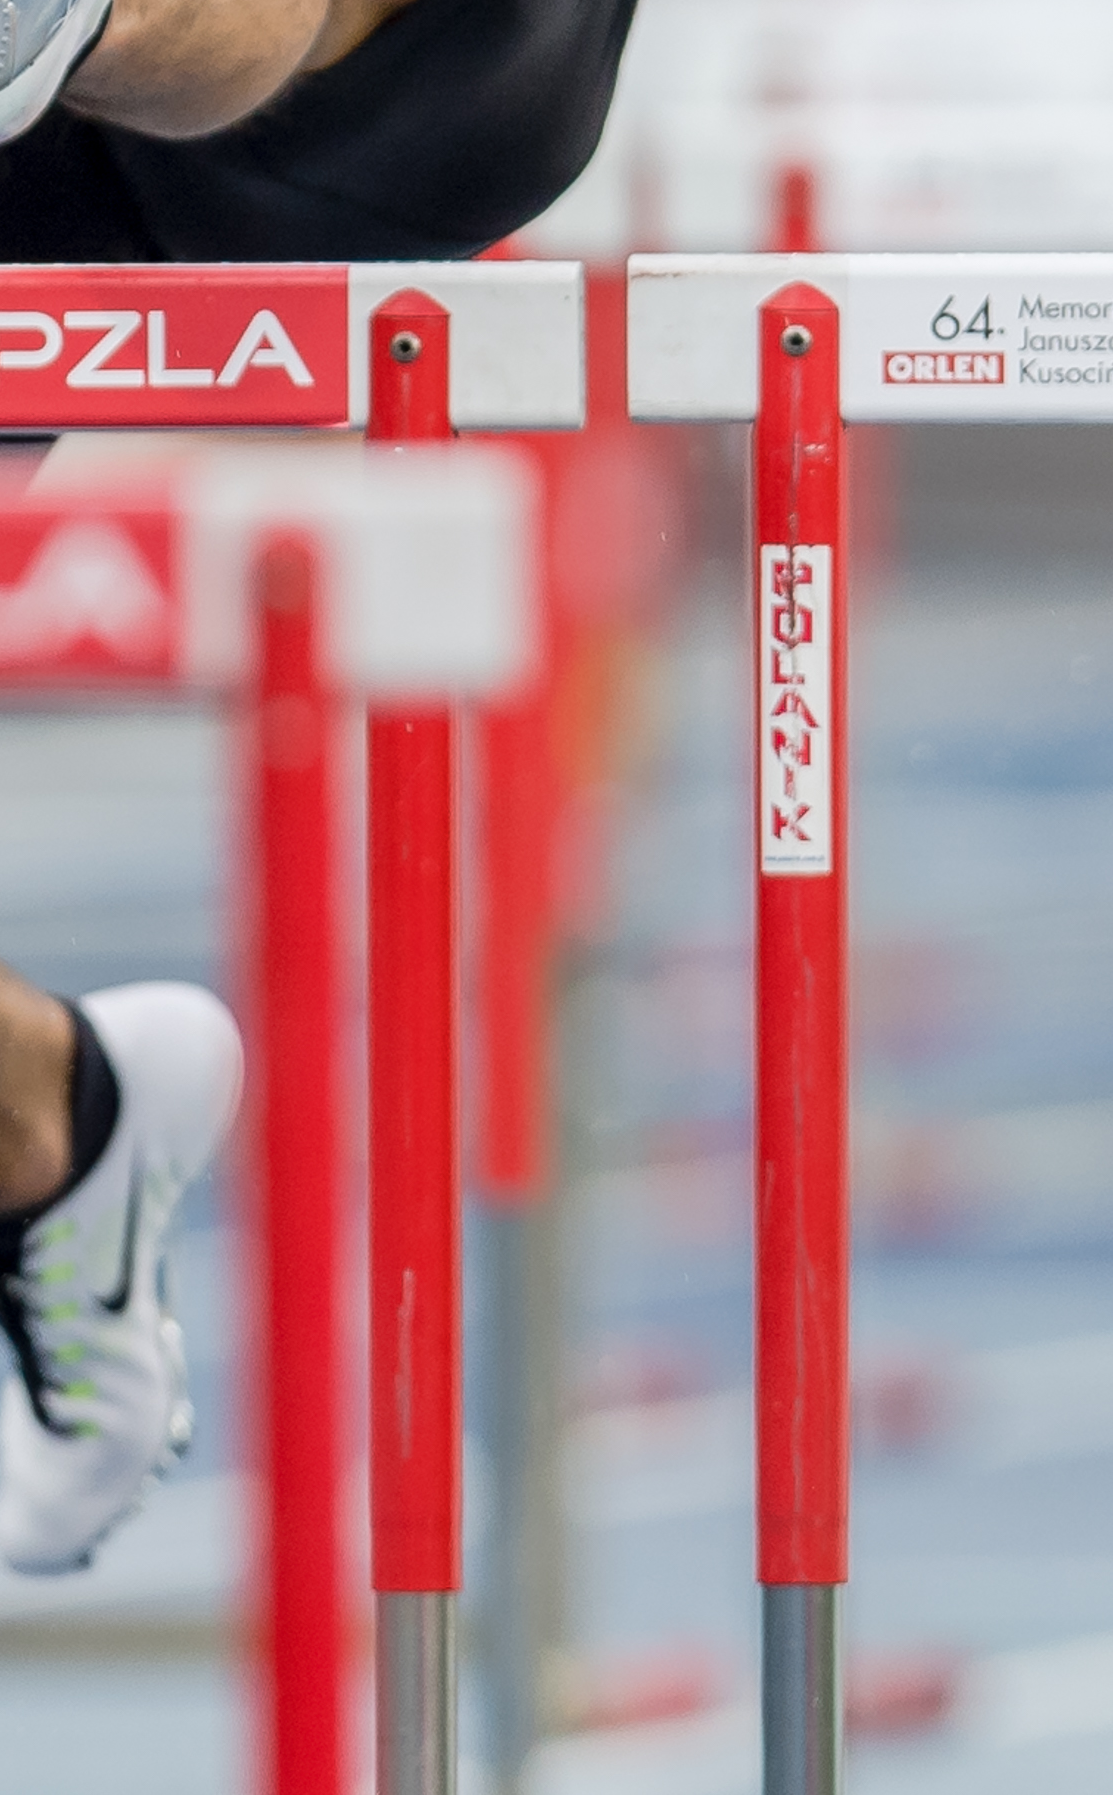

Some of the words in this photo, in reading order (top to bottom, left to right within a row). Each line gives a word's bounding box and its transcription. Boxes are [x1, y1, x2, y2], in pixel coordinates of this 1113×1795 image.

[930, 293, 1005, 341] 64.
[887, 354, 999, 382] ORLEN
[771, 558, 820, 843] POLANIK
